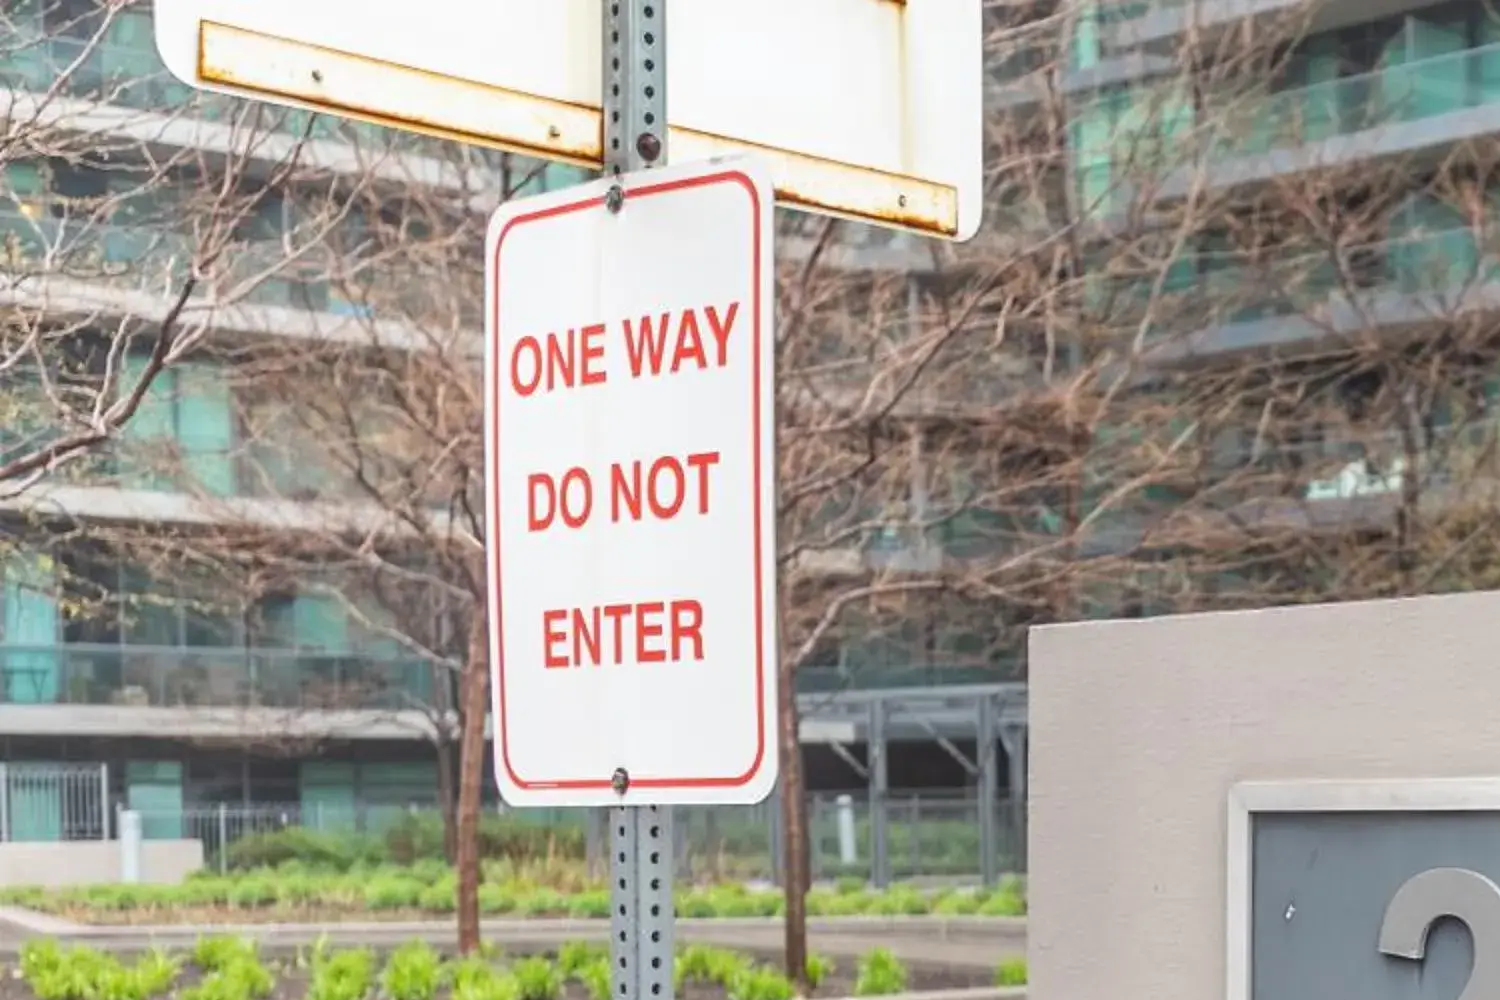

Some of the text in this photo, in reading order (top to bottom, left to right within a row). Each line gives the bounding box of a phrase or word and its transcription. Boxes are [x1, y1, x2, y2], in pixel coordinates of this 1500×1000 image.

[510, 302, 739, 398] ONE WAY
[527, 451, 721, 533] DO NOT
[542, 599, 704, 670] ENTER
